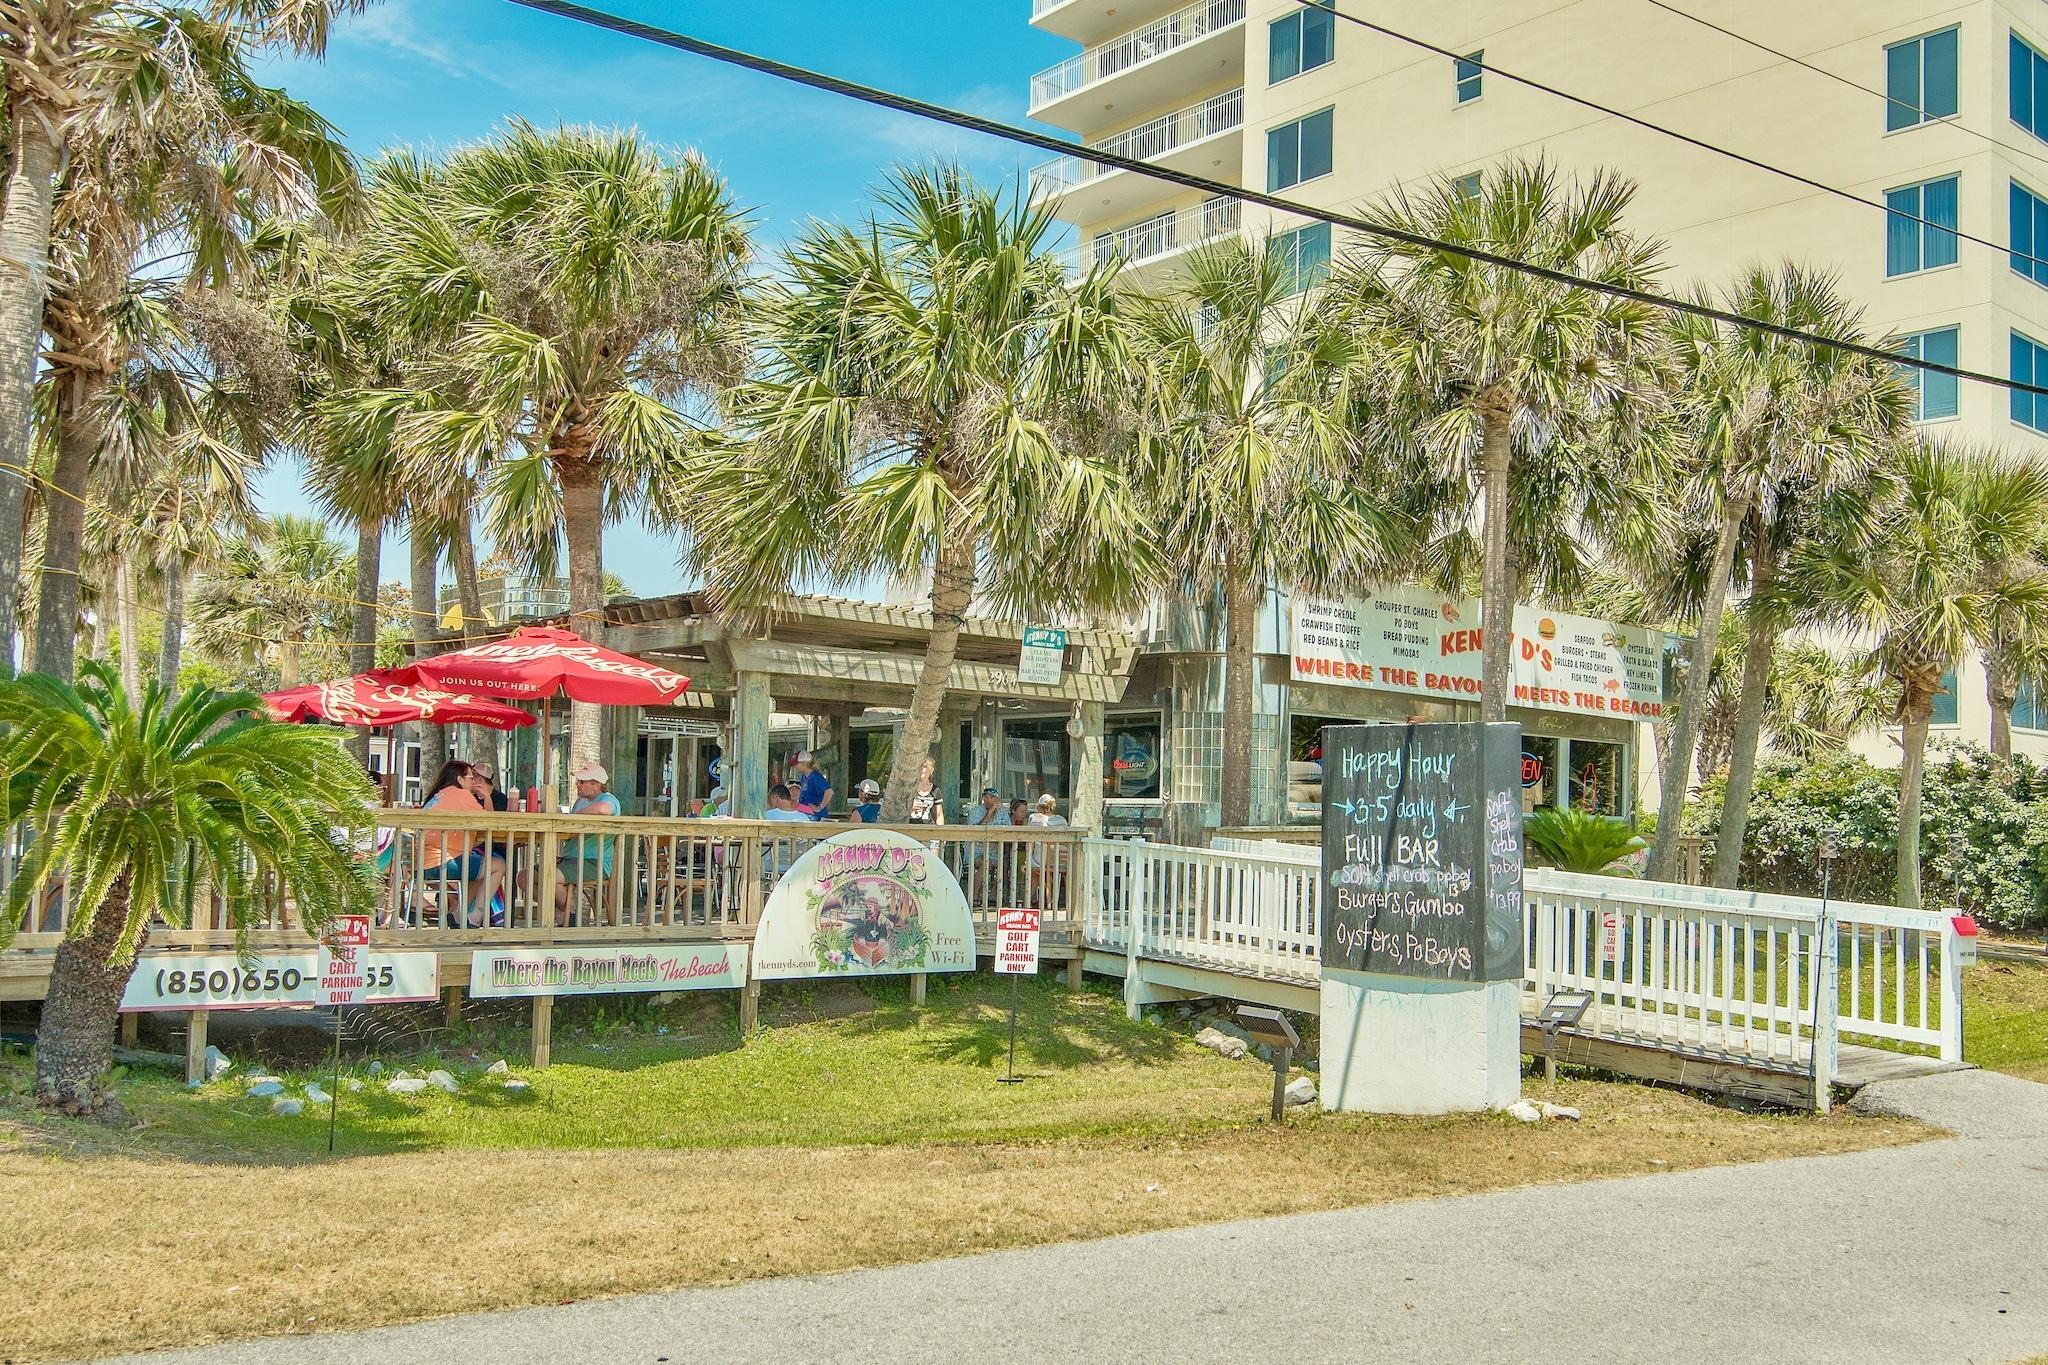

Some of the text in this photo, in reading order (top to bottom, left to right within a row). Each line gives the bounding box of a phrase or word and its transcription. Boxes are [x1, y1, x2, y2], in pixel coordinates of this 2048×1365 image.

[1308, 604, 1356, 620] SHRIMP CREOLE
[1374, 600, 1438, 619] GROUPER ST. CHARLES
[1301, 618, 1334, 631] CRAWFISH
[1394, 618, 1419, 630] PO BOYS
[1303, 633, 1316, 644] RED
[1317, 636, 1338, 647] BEANS
[1345, 640, 1360, 650] RICE
[1383, 631, 1429, 646] BREAD PUDDING
[1574, 634, 1596, 646] SEAFOOD
[1392, 646, 1420, 659] MIMOSAS
[1521, 637, 1553, 673] D'S
[1562, 645, 1607, 661] BURGERS STEAKS
[1627, 643, 1655, 656] OYSTER BAR
[1554, 657, 1574, 668] GRILLED
[1579, 660, 1593, 671] FRIED
[1593, 663, 1614, 674] CHICKEN
[1623, 655, 1637, 667] PASTA
[1642, 658, 1658, 669] SALADS
[1571, 672, 1598, 685] FISH TACOS
[1627, 669, 1655, 681] KEY LIME PIE
[439, 676, 466, 685] JOIN
[470, 679, 484, 687] US
[486, 681, 508, 689] OUT
[1295, 655, 1374, 684] WHERE
[1379, 666, 1420, 690] THE
[1514, 684, 1571, 708] MEETS
[1573, 691, 1606, 713] THE
[1610, 697, 1662, 720] BEACH
[1623, 680, 1658, 694] FROZEN DRINKS
[1342, 742, 1455, 789] Happy Hour
[1521, 759, 1542, 781] EN
[1354, 795, 1436, 839] 3-5 daily
[1397, 834, 1441, 867] BAR
[816, 843, 927, 882] KENNY D'S
[936, 932, 961, 946] Free
[1007, 932, 1029, 942] GOLF
[331, 947, 357, 961] GLF
[1006, 942, 1030, 952] CART
[931, 951, 965, 964] Wi-Fi
[999, 953, 1035, 962] PARKING
[329, 961, 358, 975] CART
[492, 957, 542, 987] Where
[542, 954, 569, 986] the
[571, 955, 617, 989] Bayou
[618, 954, 658, 984] Meets
[685, 952, 730, 978] Beach
[1006, 963, 1026, 972] ONLY
[156, 966, 394, 997] (850)650-55
[321, 976, 363, 989] PARKING
[330, 991, 353, 1003] ONLY
